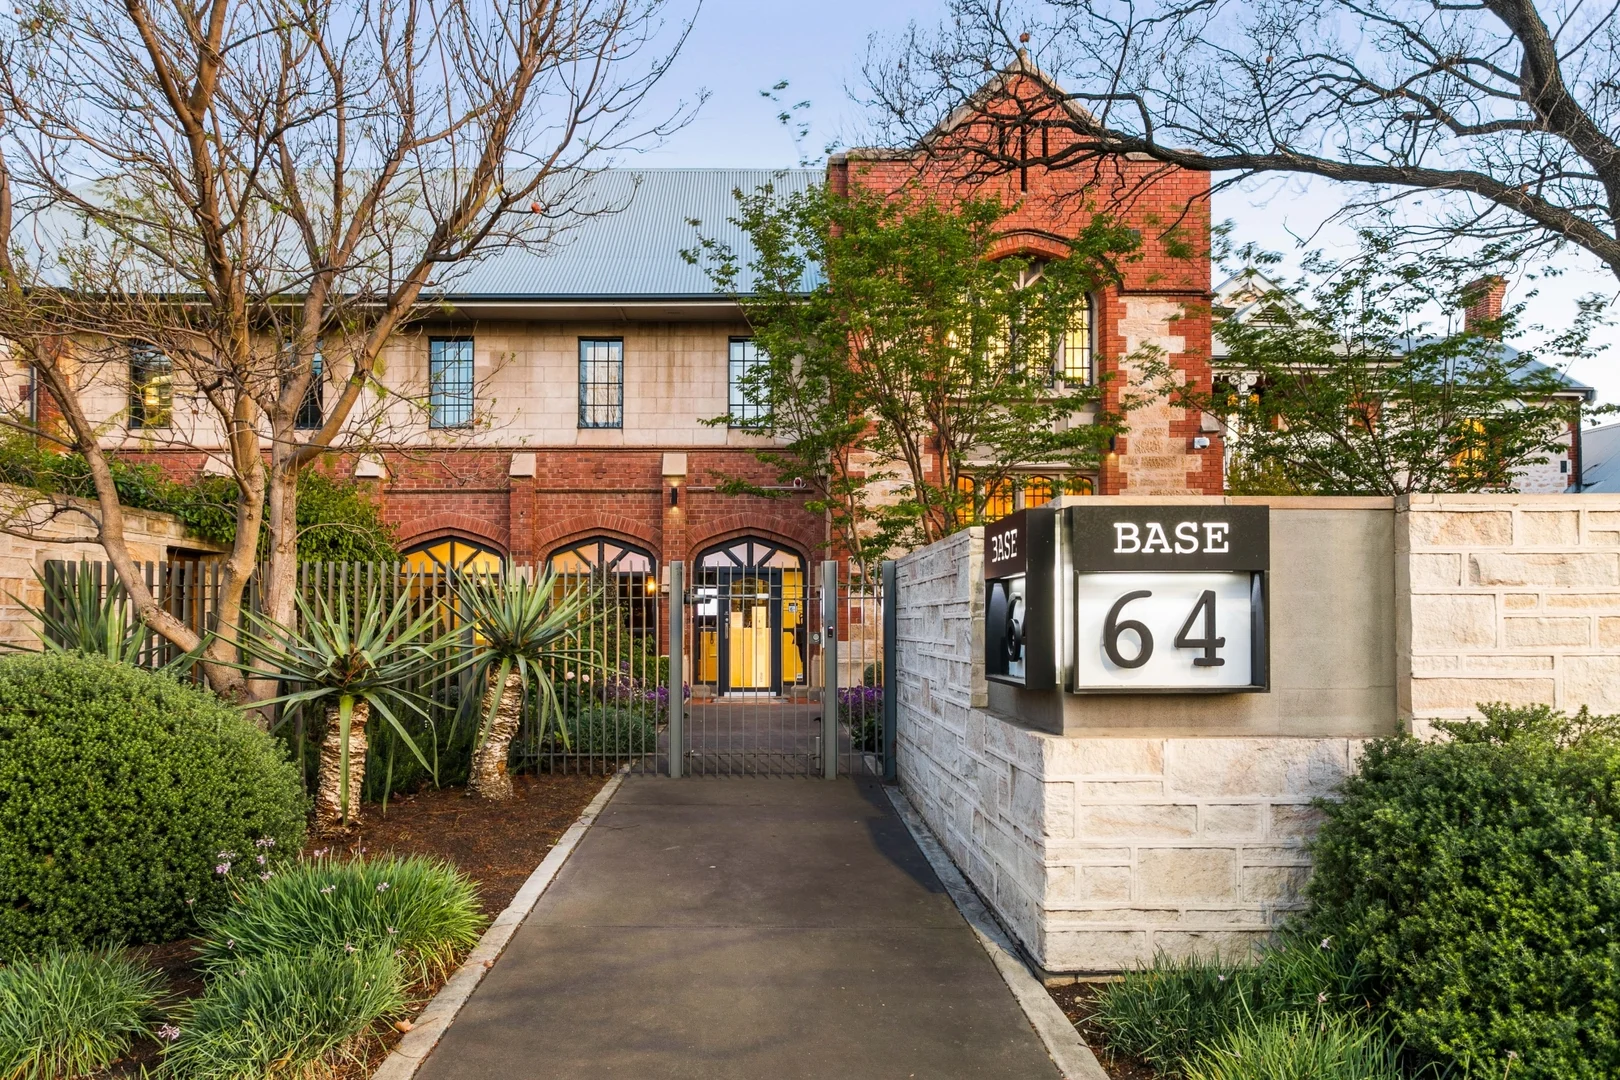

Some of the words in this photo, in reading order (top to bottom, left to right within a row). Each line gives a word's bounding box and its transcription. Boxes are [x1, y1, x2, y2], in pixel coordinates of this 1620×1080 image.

[991, 528, 1018, 563] BASE
[1113, 521, 1230, 555] BASE
[1006, 592, 1026, 662] 6
[1103, 589, 1226, 669] 64
